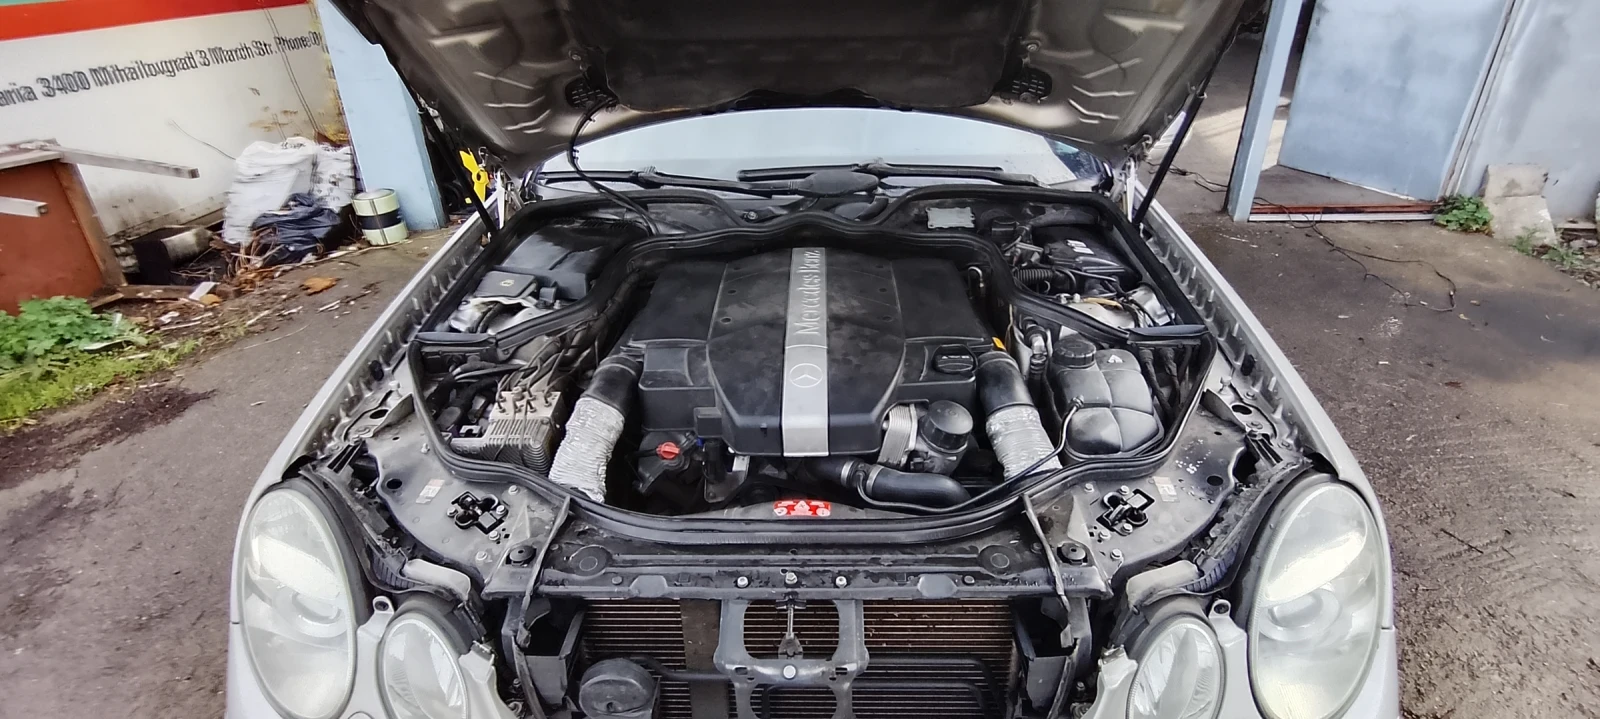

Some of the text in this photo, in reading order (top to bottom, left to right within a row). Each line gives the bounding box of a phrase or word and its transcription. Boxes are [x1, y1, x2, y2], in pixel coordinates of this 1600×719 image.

[36, 71, 91, 98] 3400
[88, 52, 198, 87] Mihailovgrad
[196, 50, 211, 67] 3
[207, 43, 254, 65] March
